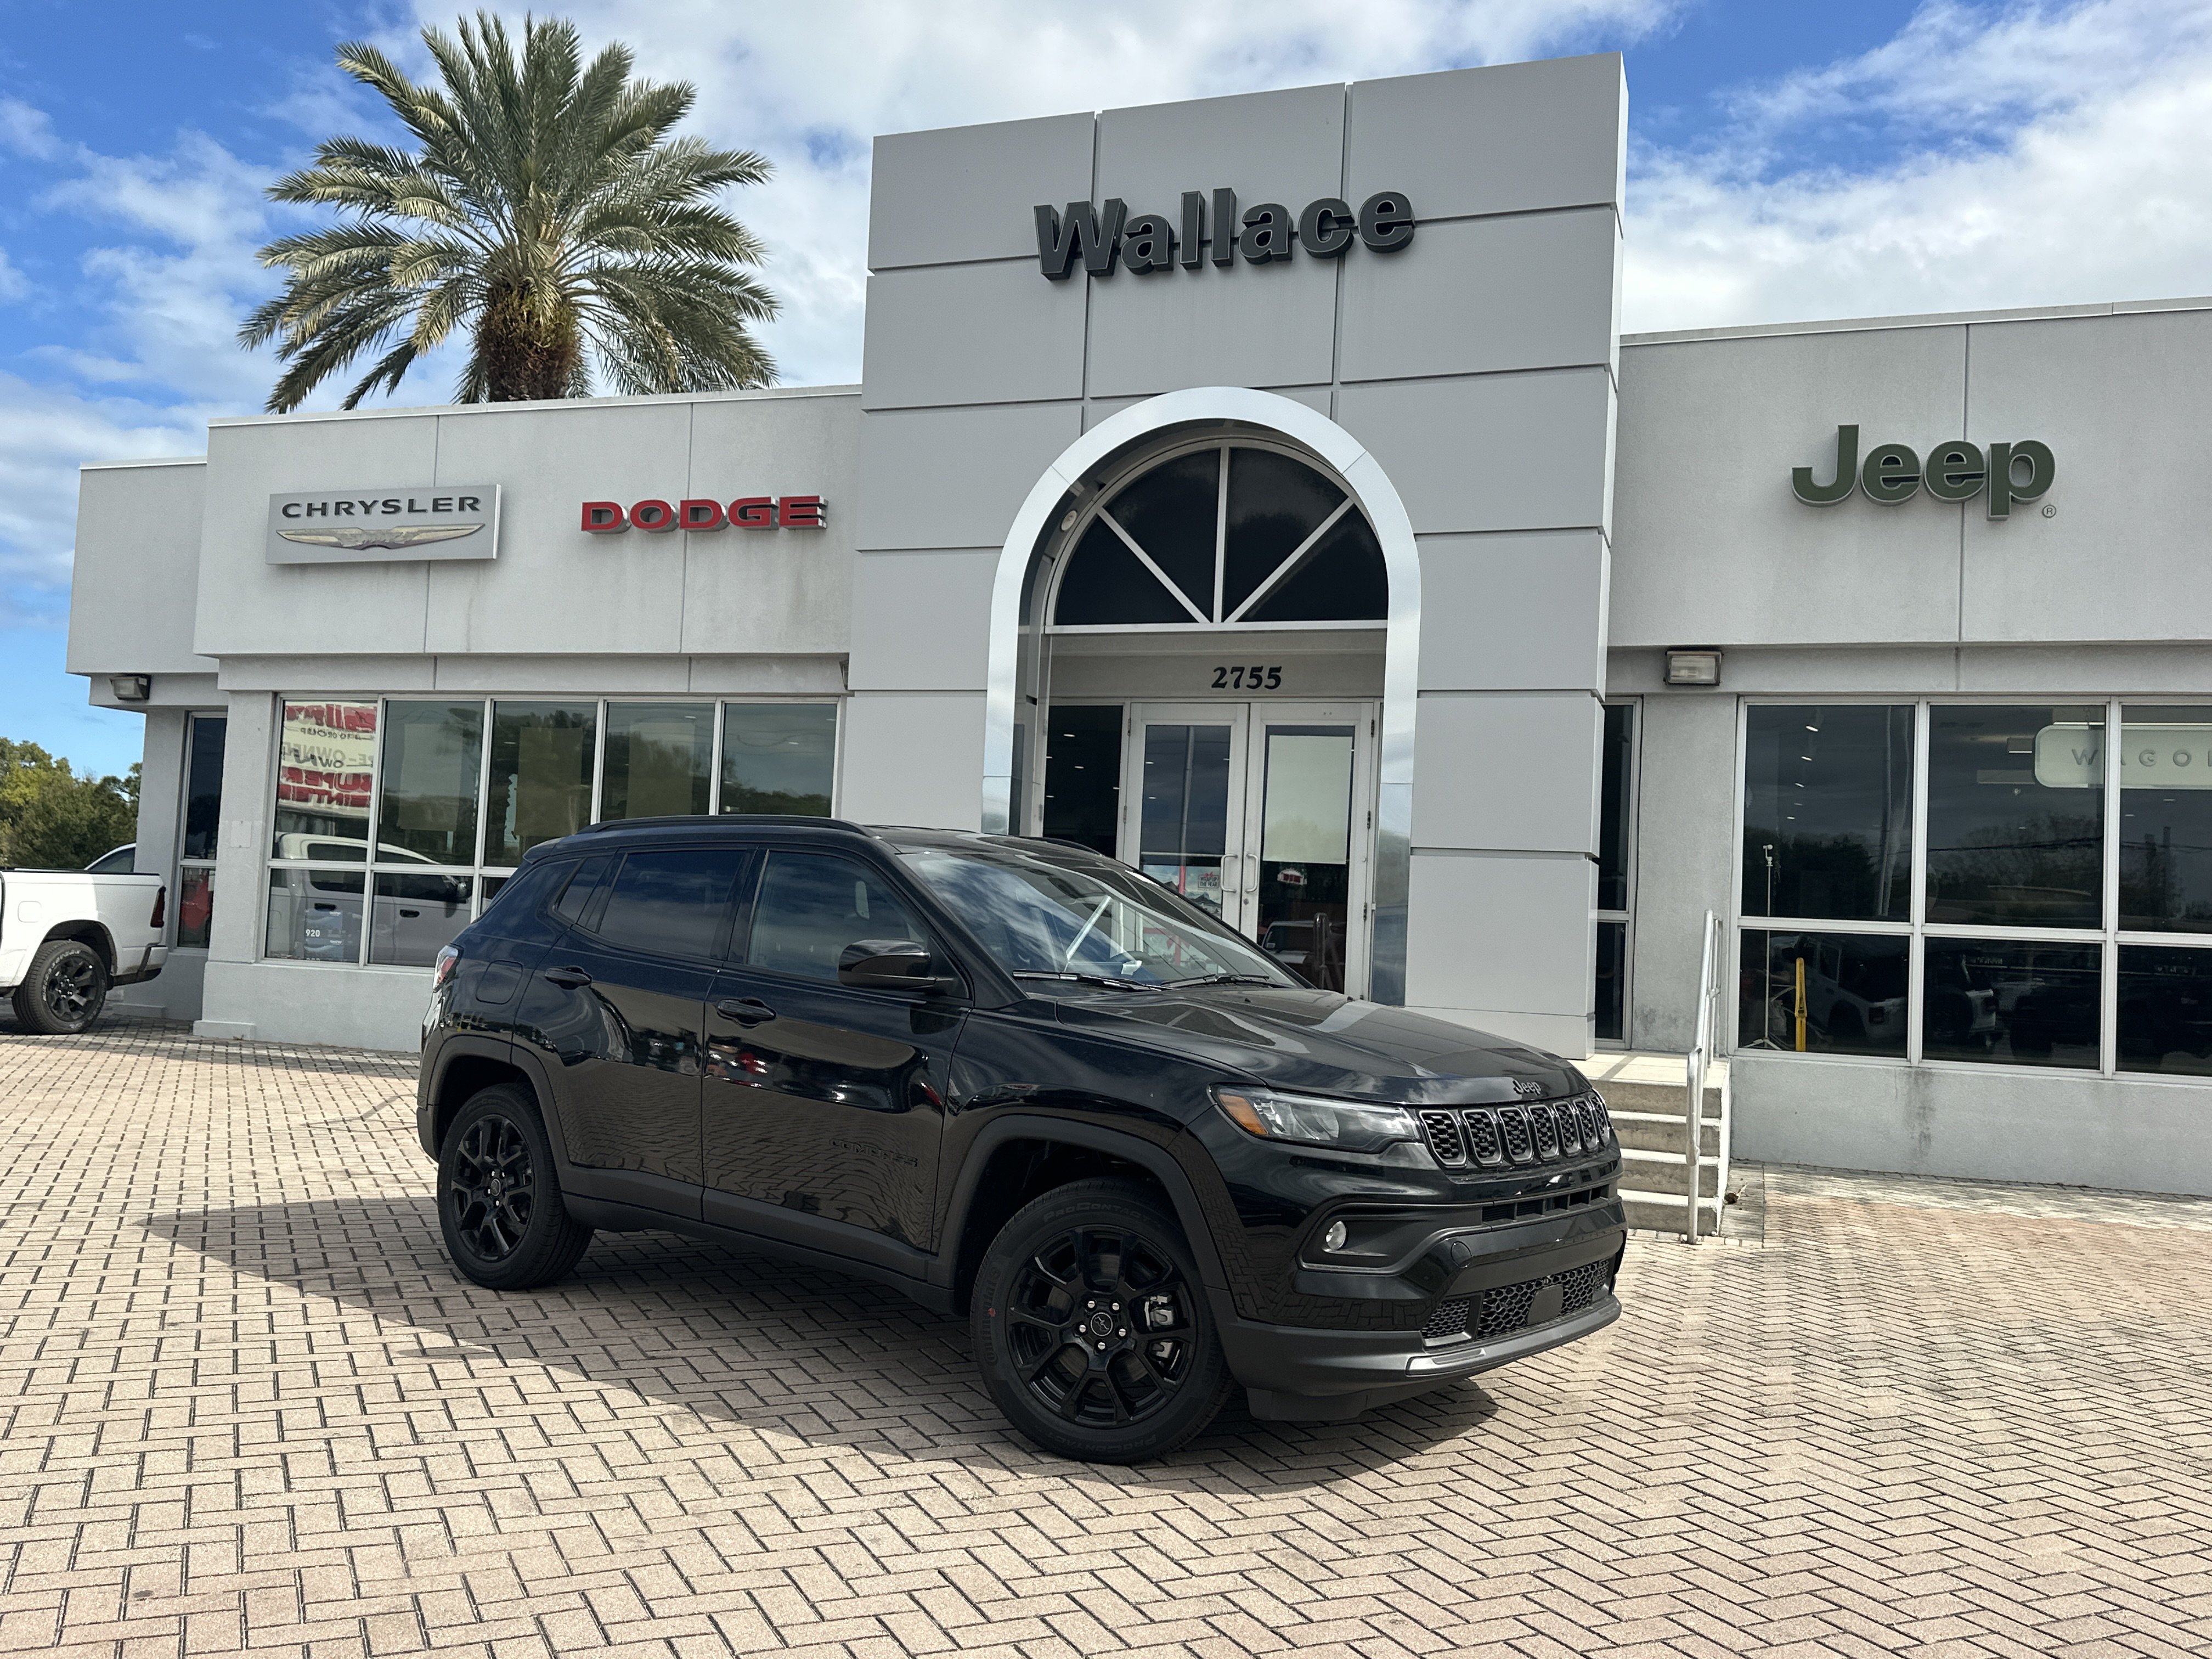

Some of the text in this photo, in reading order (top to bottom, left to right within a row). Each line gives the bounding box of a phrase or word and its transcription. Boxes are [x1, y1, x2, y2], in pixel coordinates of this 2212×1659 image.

[1034, 187, 1414, 279] Wallace
[1792, 424, 2056, 520] Jeep
[281, 496, 481, 518] CHRYSLER
[581, 495, 827, 533] DODGE
[1211, 665, 1282, 690] 2755
[2072, 748, 2212, 767] WGO
[306, 929, 320, 937] 920
[1513, 1079, 1541, 1096] Jeep
[829, 1138, 919, 1167] COMPASS
